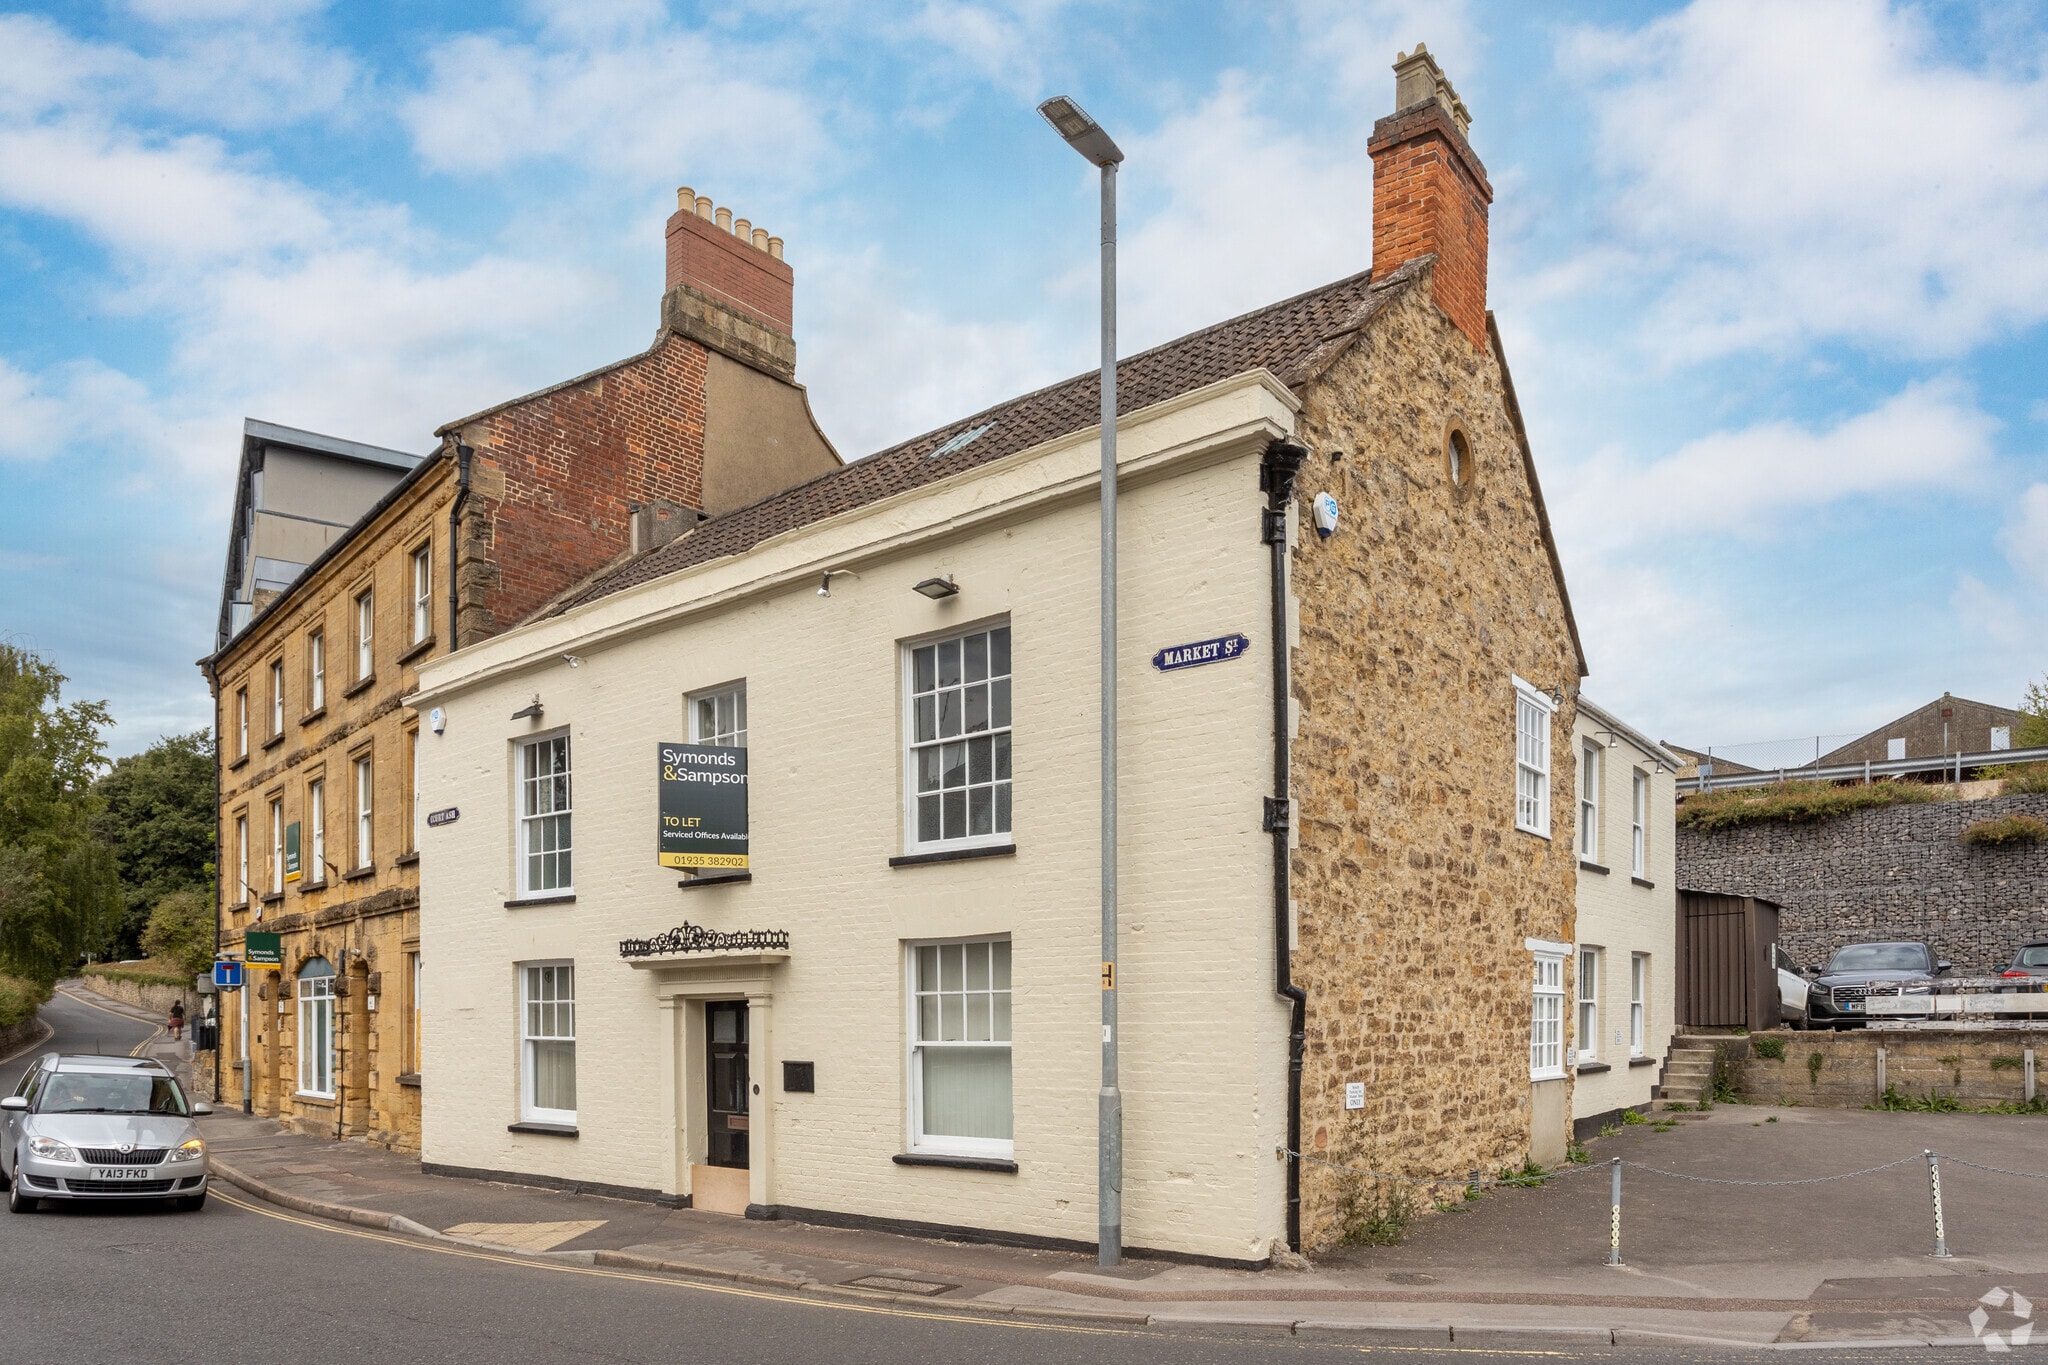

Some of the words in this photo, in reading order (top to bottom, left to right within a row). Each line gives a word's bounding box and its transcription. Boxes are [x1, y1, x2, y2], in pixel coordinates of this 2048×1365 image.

[1163, 642, 1220, 666] MARKET
[662, 748, 736, 766] Symonds
[663, 816, 679, 827] TO
[682, 817, 701, 828] LET
[662, 830, 694, 839] Serviced
[694, 831, 720, 840] Offices
[720, 832, 749, 841] Availabl
[674, 855, 705, 866] 01935
[99, 1169, 124, 1179] YA13
[126, 1169, 148, 1179] FKD
